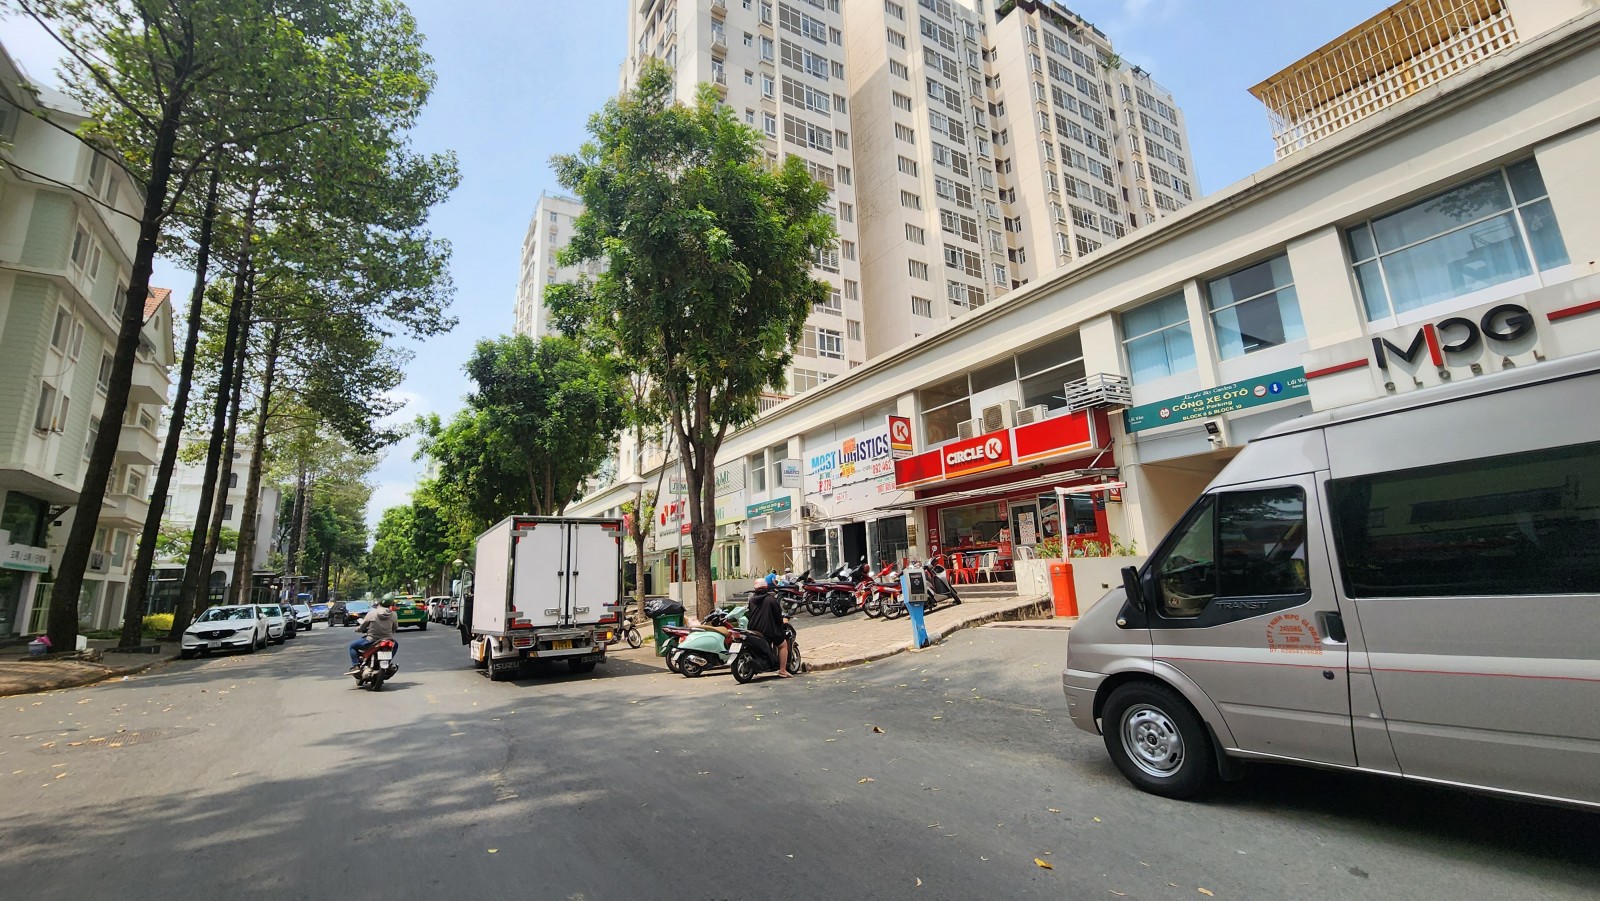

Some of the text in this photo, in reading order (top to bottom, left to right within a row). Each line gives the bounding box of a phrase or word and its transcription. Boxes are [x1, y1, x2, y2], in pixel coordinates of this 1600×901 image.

[1384, 350, 1546, 392] GLOBAL
[1172, 399, 1204, 412] CỔNG
[1206, 394, 1222, 405] XE
[1206, 400, 1233, 410] Parking
[1182, 411, 1203, 421] BLOCK
[1213, 405, 1235, 415] BLOCK
[946, 445, 984, 465] CIRCLE
[1216, 601, 1269, 609] TRANSIT
[581, 655, 605, 663] ISUZU
[493, 661, 520, 671] ISUZU
